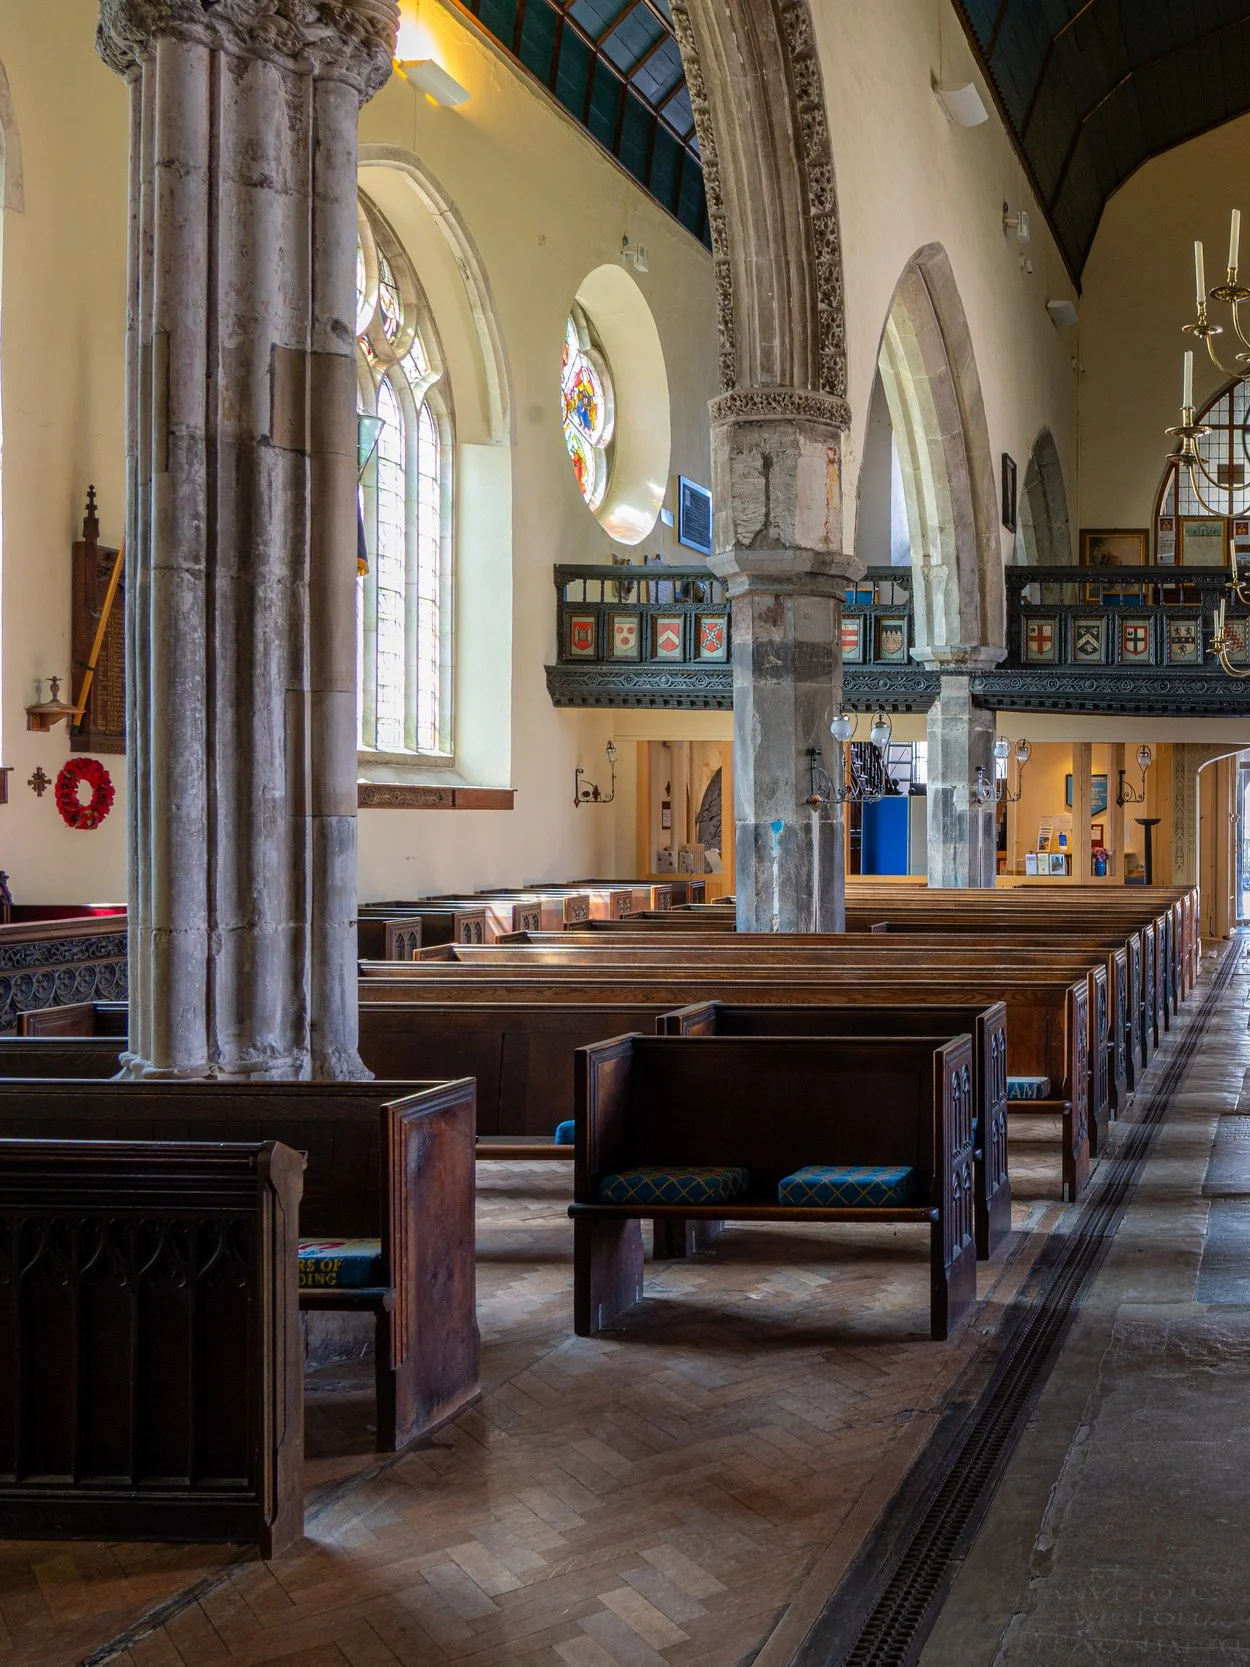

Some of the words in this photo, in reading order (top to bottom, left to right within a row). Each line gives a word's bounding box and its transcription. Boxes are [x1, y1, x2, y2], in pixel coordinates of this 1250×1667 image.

[1009, 1083, 1037, 1099] AM
[320, 1259, 341, 1271] OF
[299, 1273, 337, 1286] DING
